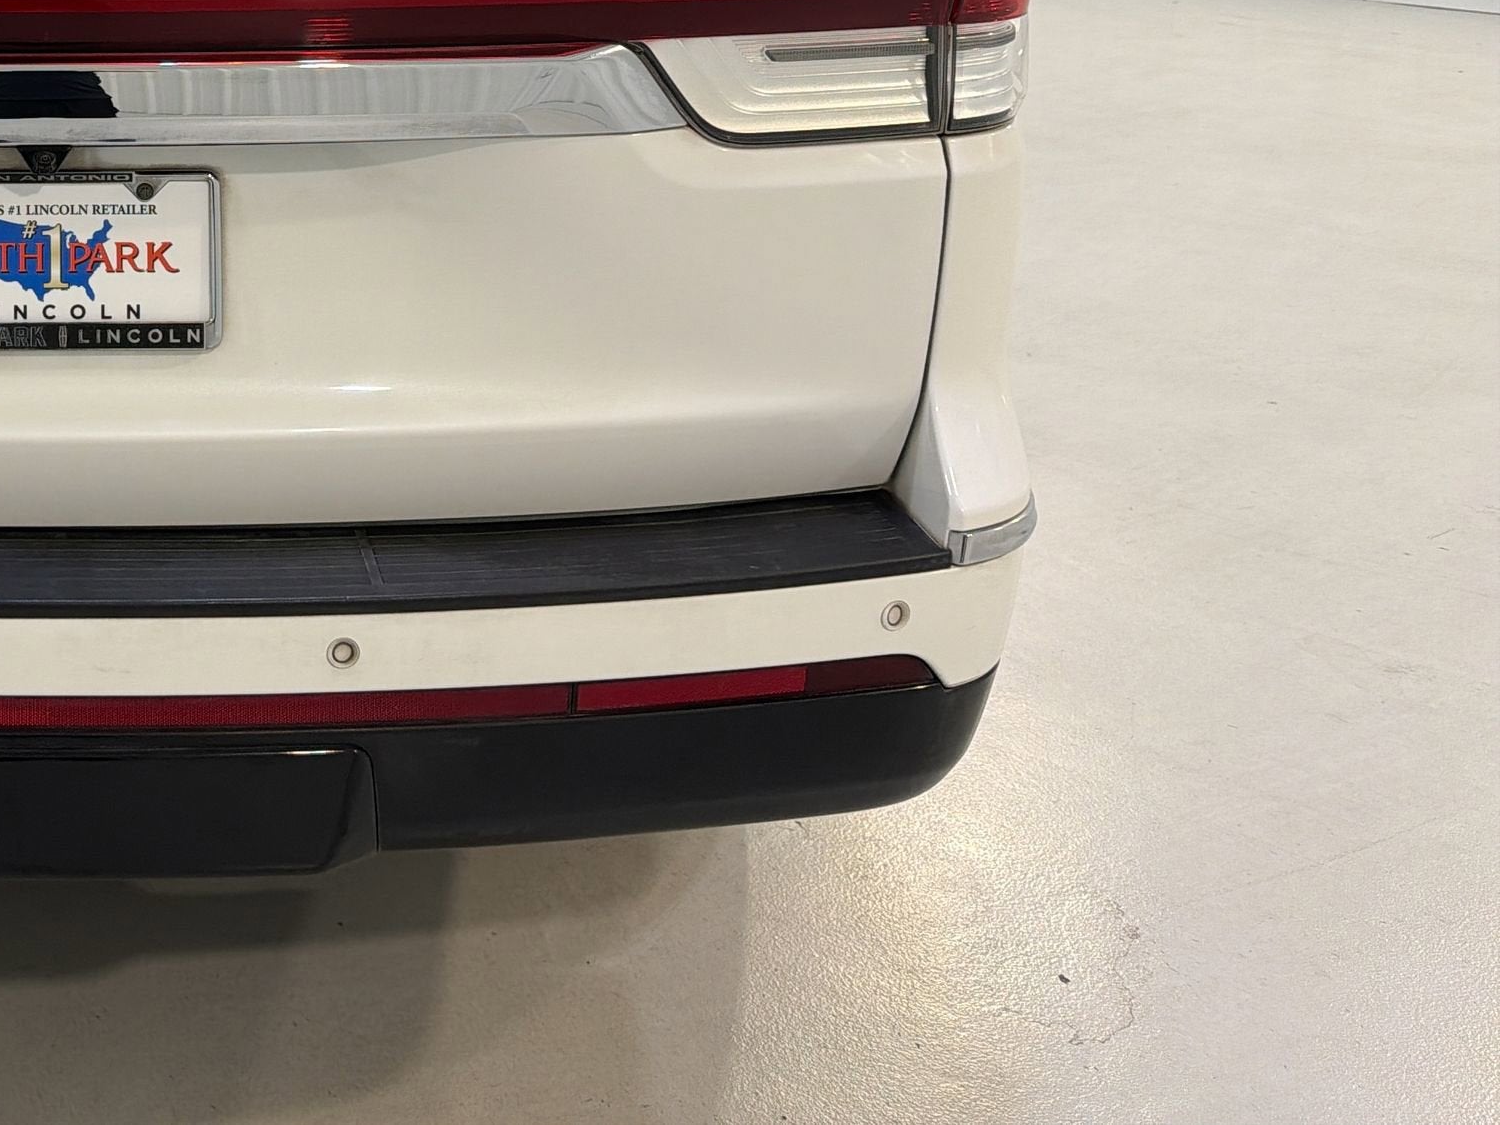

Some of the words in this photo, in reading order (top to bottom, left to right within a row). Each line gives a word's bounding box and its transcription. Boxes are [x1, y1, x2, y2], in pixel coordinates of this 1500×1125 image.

[20, 173, 130, 182] ANTONIO
[8, 204, 22, 216] #1
[26, 204, 89, 216] LINCOLN
[92, 204, 158, 216] RETAILER
[68, 242, 180, 274] PARK
[77, 328, 201, 344] LINCOLN
